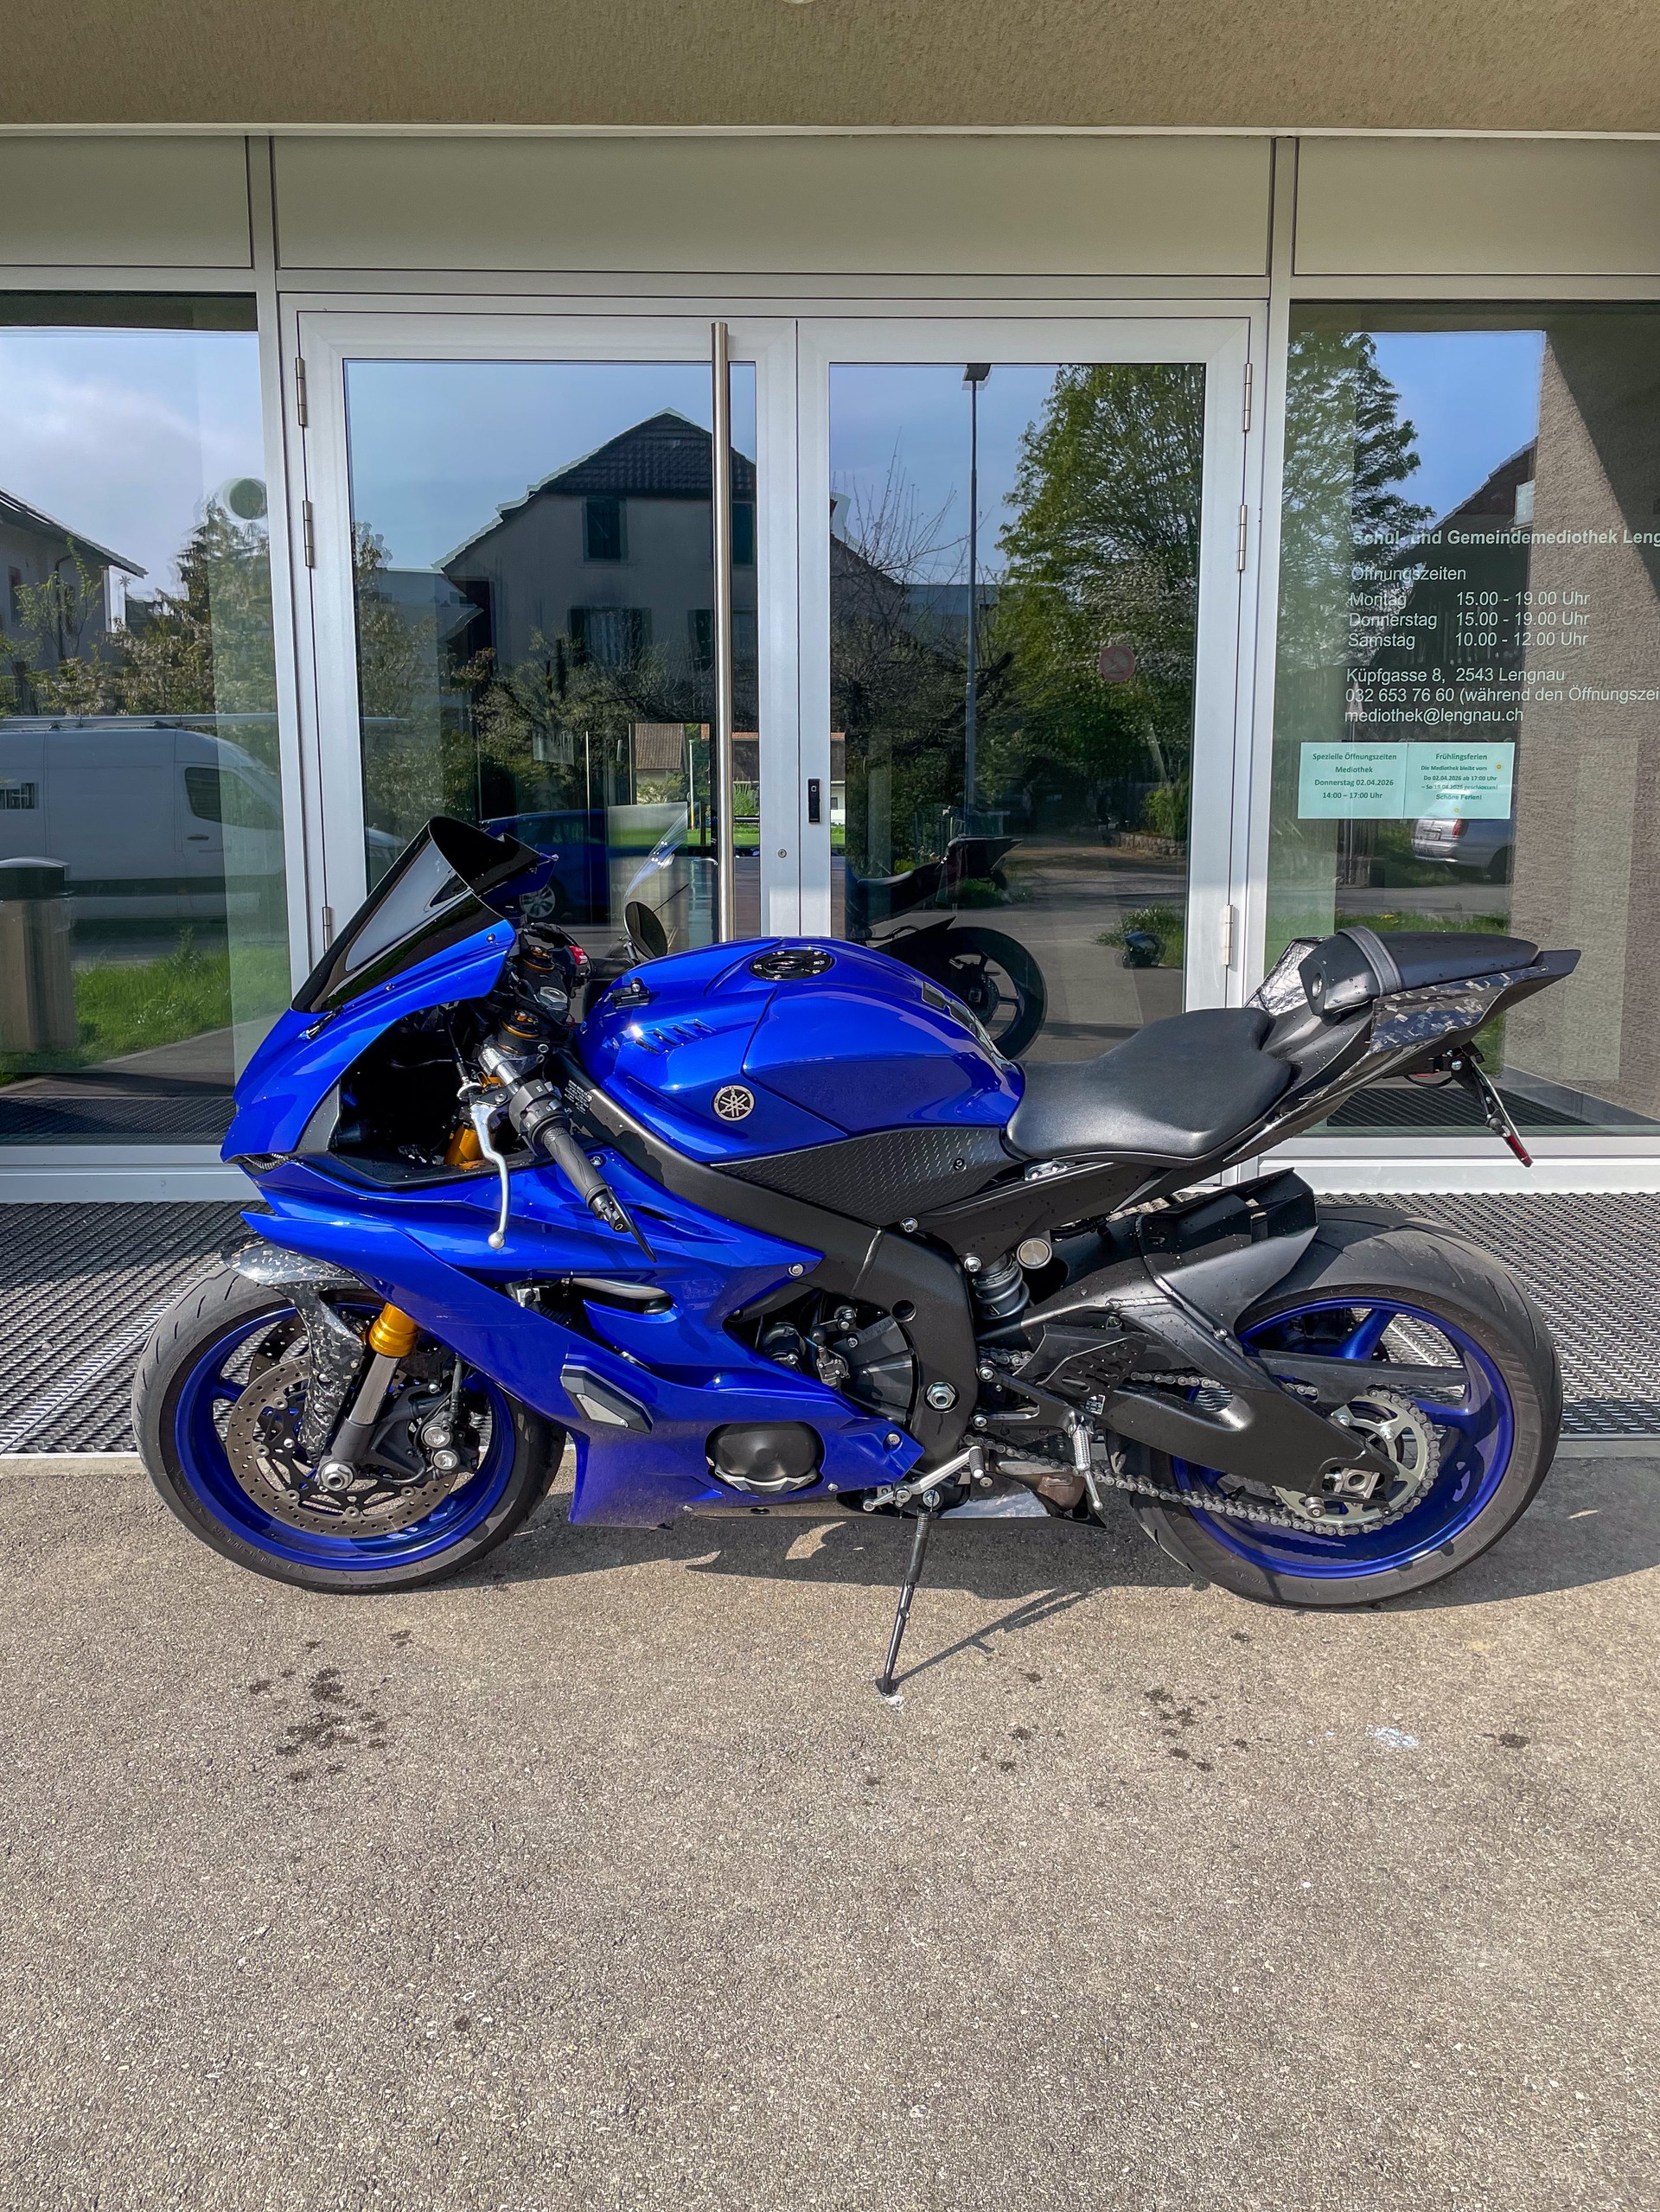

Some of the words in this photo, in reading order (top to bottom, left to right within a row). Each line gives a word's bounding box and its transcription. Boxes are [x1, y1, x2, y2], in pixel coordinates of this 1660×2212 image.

[1410, 529, 1442, 545] und
[1446, 529, 1618, 545] Gemeindemediothek
[1623, 529, 1660, 547] Leng
[1350, 563, 1467, 583] Öffnungszeiten
[1349, 591, 1408, 609] Montag
[1456, 591, 1499, 606] 15.00
[1515, 591, 1557, 605] 19.00
[1562, 591, 1591, 605] Uhr
[1348, 612, 1438, 630] Donnerstag
[1456, 611, 1498, 626] 15.00
[1514, 611, 1557, 626] 19.00
[1561, 611, 1591, 626] Uhr
[1348, 633, 1416, 650] Samstag
[1455, 632, 1497, 647] 10.00
[1513, 632, 1555, 646] 12.00
[1561, 632, 1589, 646] Uhr
[1346, 667, 1427, 685] Küpfgasse
[1432, 667, 1446, 684] 8,
[1455, 667, 1494, 682] 2543
[1498, 667, 1565, 685] Lengnau
[1344, 688, 1374, 703] 032
[1378, 688, 1408, 703] 653
[1412, 688, 1431, 702] 76
[1435, 687, 1455, 702] 60
[1459, 687, 1530, 704] (während
[1535, 687, 1563, 701] den
[1568, 684, 1660, 704] Öffnungszei
[1344, 707, 1523, 725] mediothek@lengnau.ch
[1312, 753, 1344, 762] Spezielle
[1344, 752, 1397, 762] Öffnungszeiten
[1435, 753, 1488, 762] Frühlingsferien
[1314, 779, 1355, 787] Donnerstag
